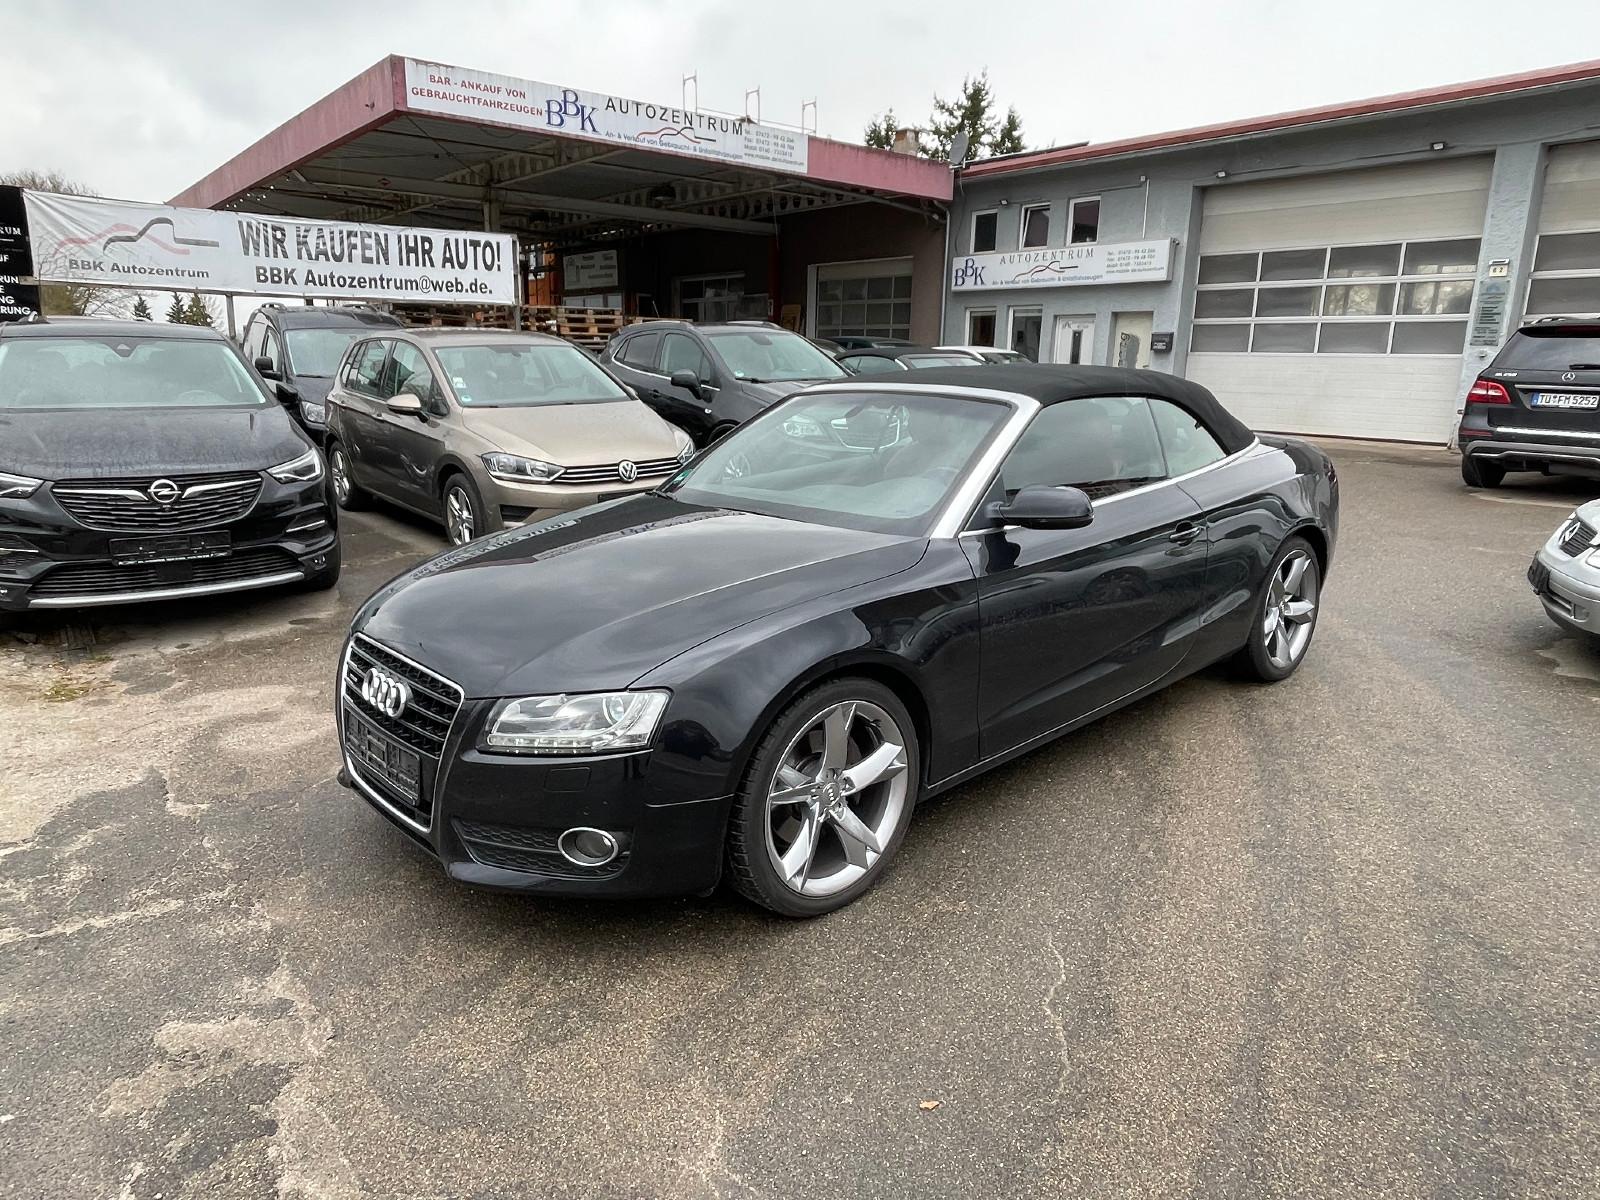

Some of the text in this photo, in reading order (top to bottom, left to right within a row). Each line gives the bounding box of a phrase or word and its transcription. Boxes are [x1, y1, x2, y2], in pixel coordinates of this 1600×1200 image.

[411, 86, 543, 116] GEBRAUCHTFAHRZEUGEN
[429, 74, 451, 86] BAR
[460, 80, 502, 95] ANKAUF
[505, 87, 527, 99] VON
[545, 89, 599, 133] BBK
[605, 97, 743, 136] AUTOZENTRUM
[646, 137, 658, 146] von
[237, 219, 502, 272] WIR KAUFEN IHR AUTO!
[999, 247, 1095, 265] AUTOZENTRUM
[68, 258, 210, 279] BBK Autozentrum
[255, 265, 493, 294] BBK Autozentrum@web.de.
[953, 257, 987, 287] BBK
[1571, 396, 1598, 406] 5252
